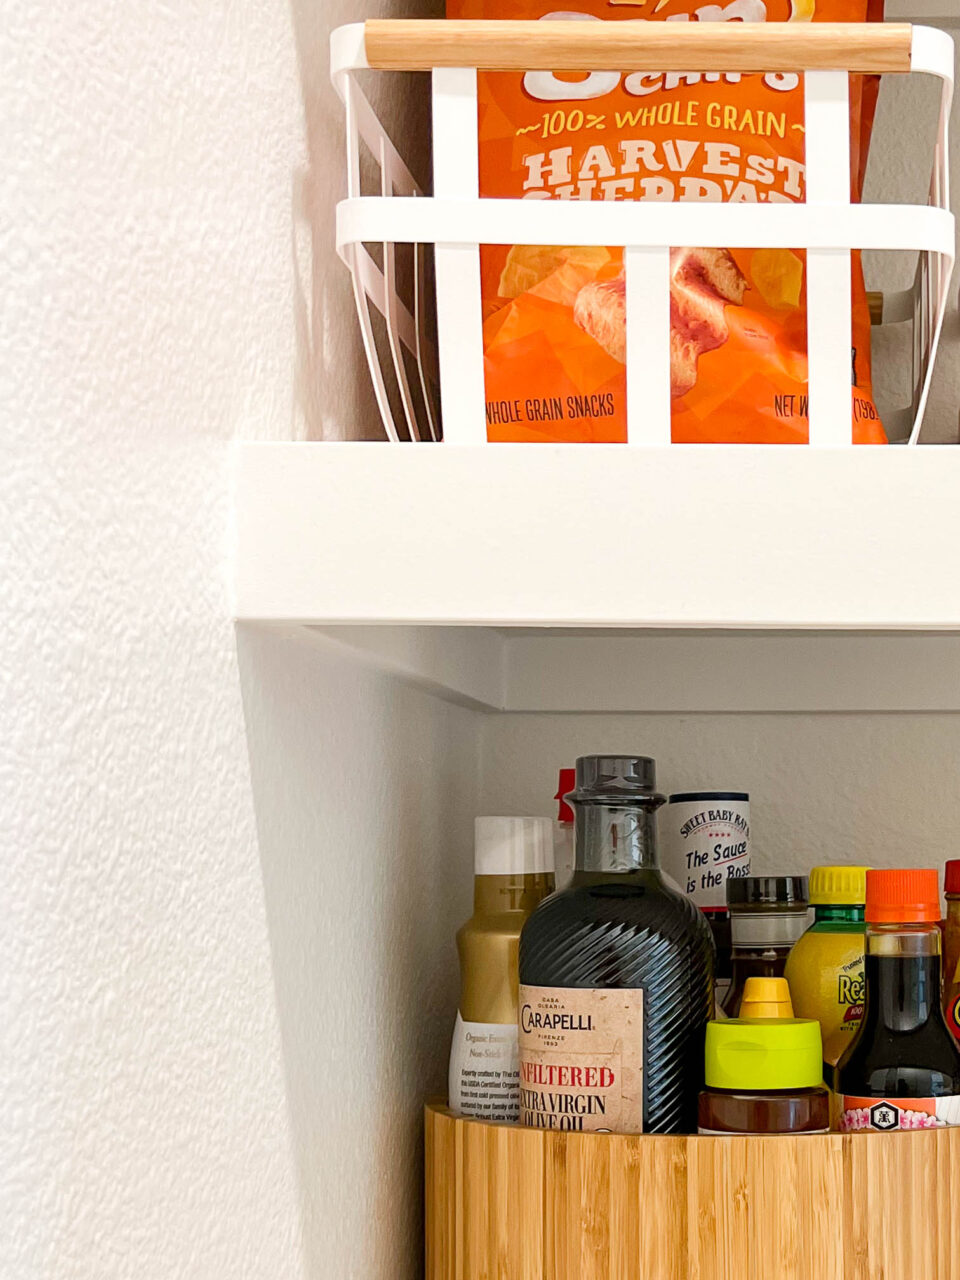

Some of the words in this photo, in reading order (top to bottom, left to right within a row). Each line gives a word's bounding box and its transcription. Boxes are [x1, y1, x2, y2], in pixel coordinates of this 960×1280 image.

[543, 110, 605, 138] 100%
[615, 102, 698, 128] WHOLE
[707, 103, 787, 138] GRAIN
[522, 140, 805, 194] HARVEST
[525, 398, 563, 421] GRAIN
[567, 393, 614, 419] SNACKS
[775, 395, 796, 417] NET
[680, 812, 706, 839] SWEET
[708, 809, 734, 821] BABY
[686, 850, 709, 869] The
[713, 841, 746, 861] Sauce
[686, 876, 696, 893] is
[701, 871, 722, 889] the
[522, 1004, 592, 1033] CARAPELLI
[521, 1061, 615, 1088] NFILTERED
[520, 1088, 546, 1112] XTRA
[548, 1092, 606, 1115] VIRGIN
